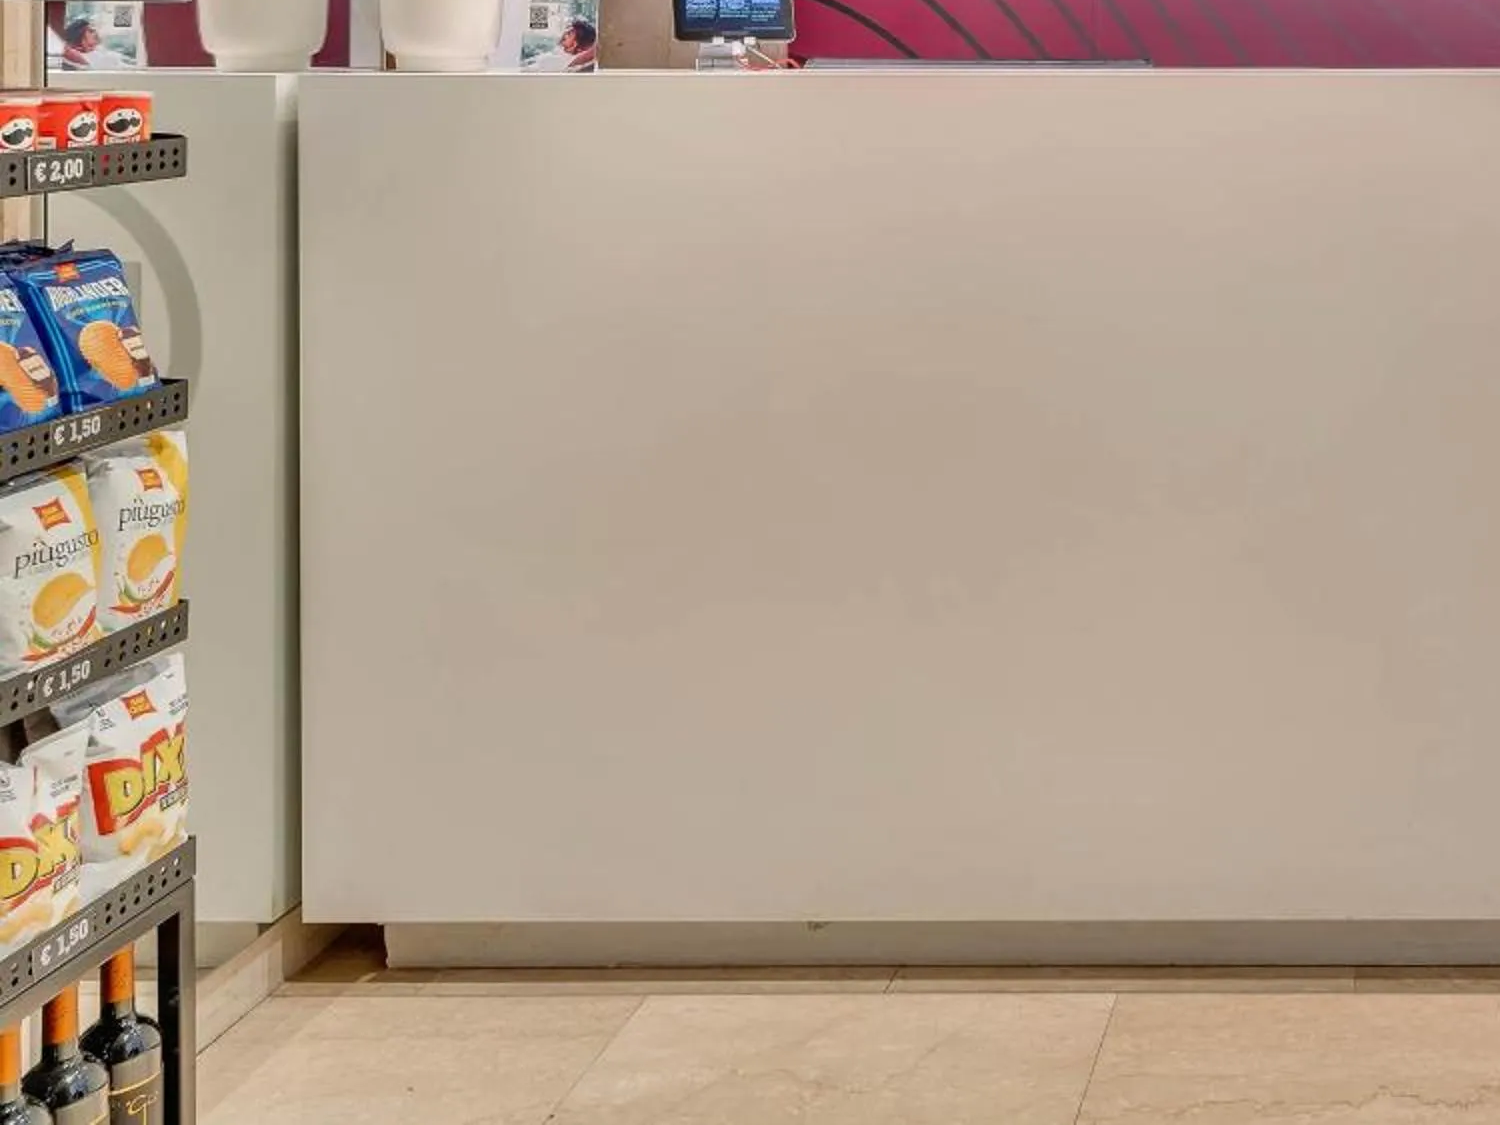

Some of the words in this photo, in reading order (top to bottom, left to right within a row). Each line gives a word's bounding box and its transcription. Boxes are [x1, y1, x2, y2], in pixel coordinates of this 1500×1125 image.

[34, 162, 47, 183] €
[50, 158, 84, 184] 2,00
[53, 425, 66, 445] €
[69, 415, 102, 443] 1,50
[43, 677, 55, 698] €
[58, 660, 91, 691] 1,50
[40, 945, 52, 966] €
[56, 918, 89, 956] 1,50
